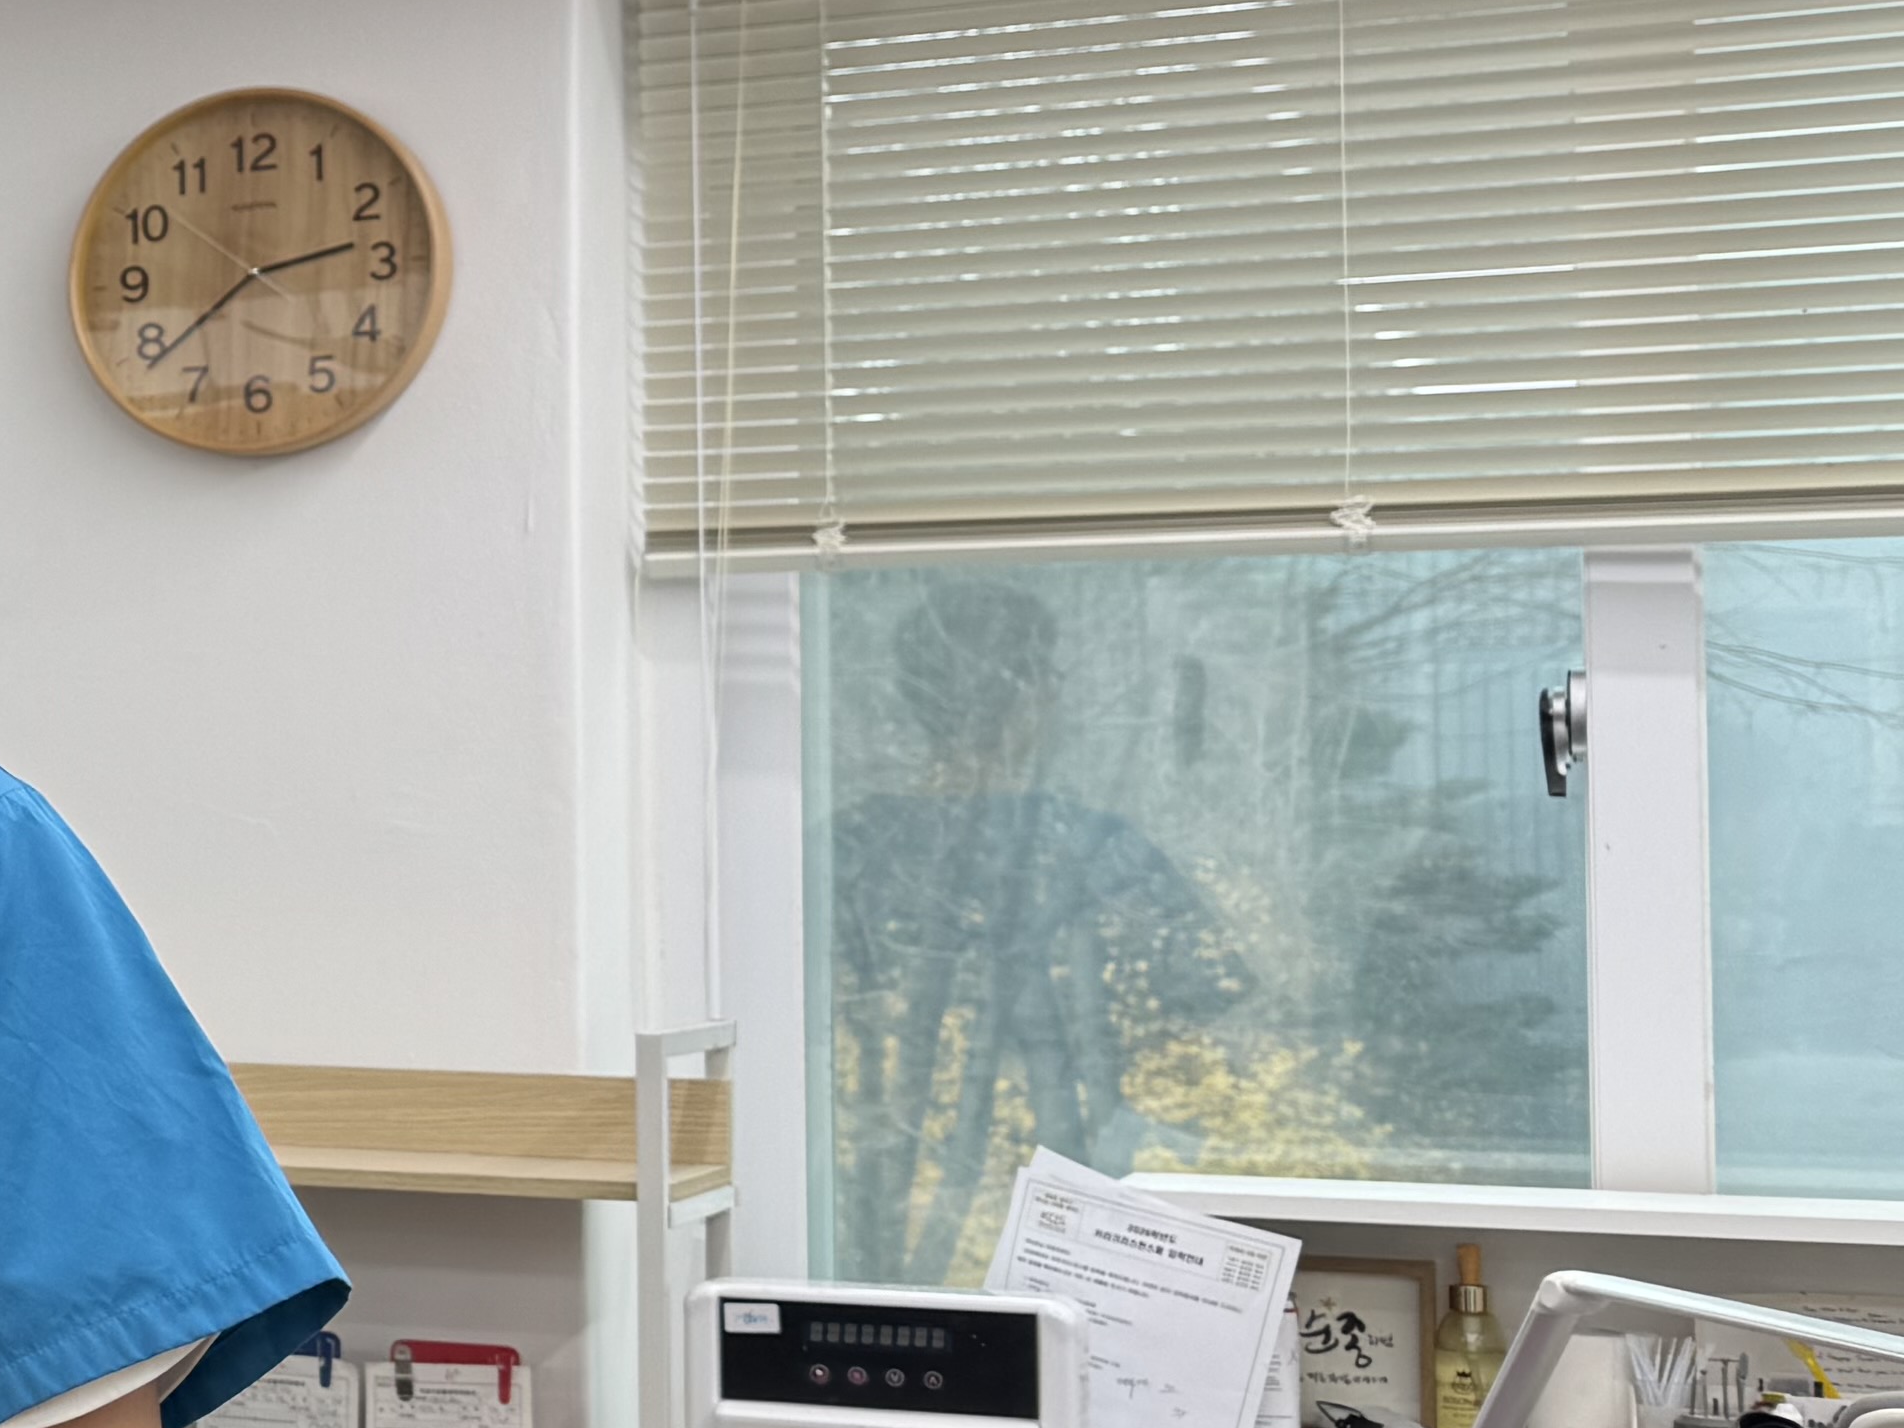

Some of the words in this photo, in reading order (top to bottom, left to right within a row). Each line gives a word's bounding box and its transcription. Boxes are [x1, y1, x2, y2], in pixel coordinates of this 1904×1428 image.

[230, 133, 277, 173] 12
[309, 143, 323, 181] 1
[172, 157, 206, 195] 11
[352, 183, 381, 221] 2
[125, 205, 169, 244] 10
[370, 241, 397, 280] 3
[120, 266, 149, 303] 9
[137, 323, 169, 360] 8
[352, 304, 381, 342] 4
[182, 365, 209, 403] 7
[308, 355, 336, 393] 5
[244, 375, 272, 413] 6
